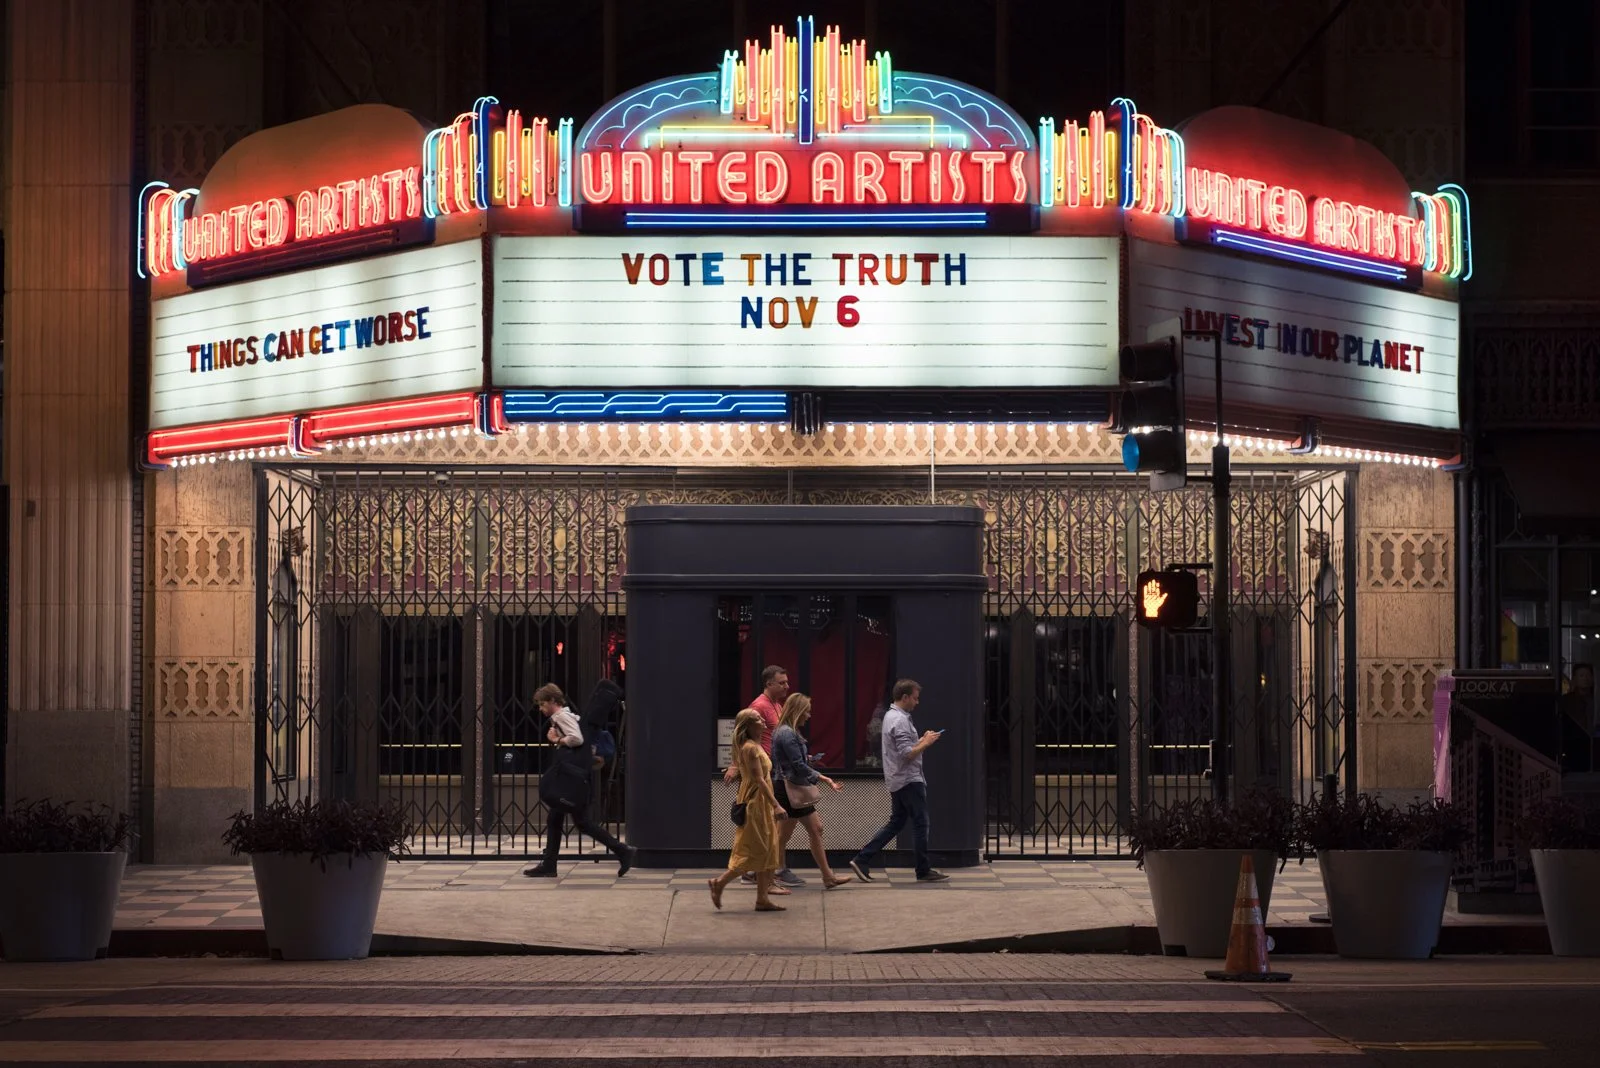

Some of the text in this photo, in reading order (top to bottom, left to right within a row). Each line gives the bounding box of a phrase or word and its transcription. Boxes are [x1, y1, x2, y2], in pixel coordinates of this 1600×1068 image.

[581, 151, 1028, 203] UNITED ARTISTS
[182, 165, 422, 263] UNITED ARTISTS
[1190, 167, 1426, 265] UNITED ARTISTS
[621, 252, 967, 286] VOTE THE TRUTH
[187, 306, 432, 373] THINGS CAN GET WORSE
[741, 295, 861, 329] NOV 6
[1184, 306, 1425, 374] INVEST IN OUR PLANET
[1460, 680, 1517, 693] LOOK AT
